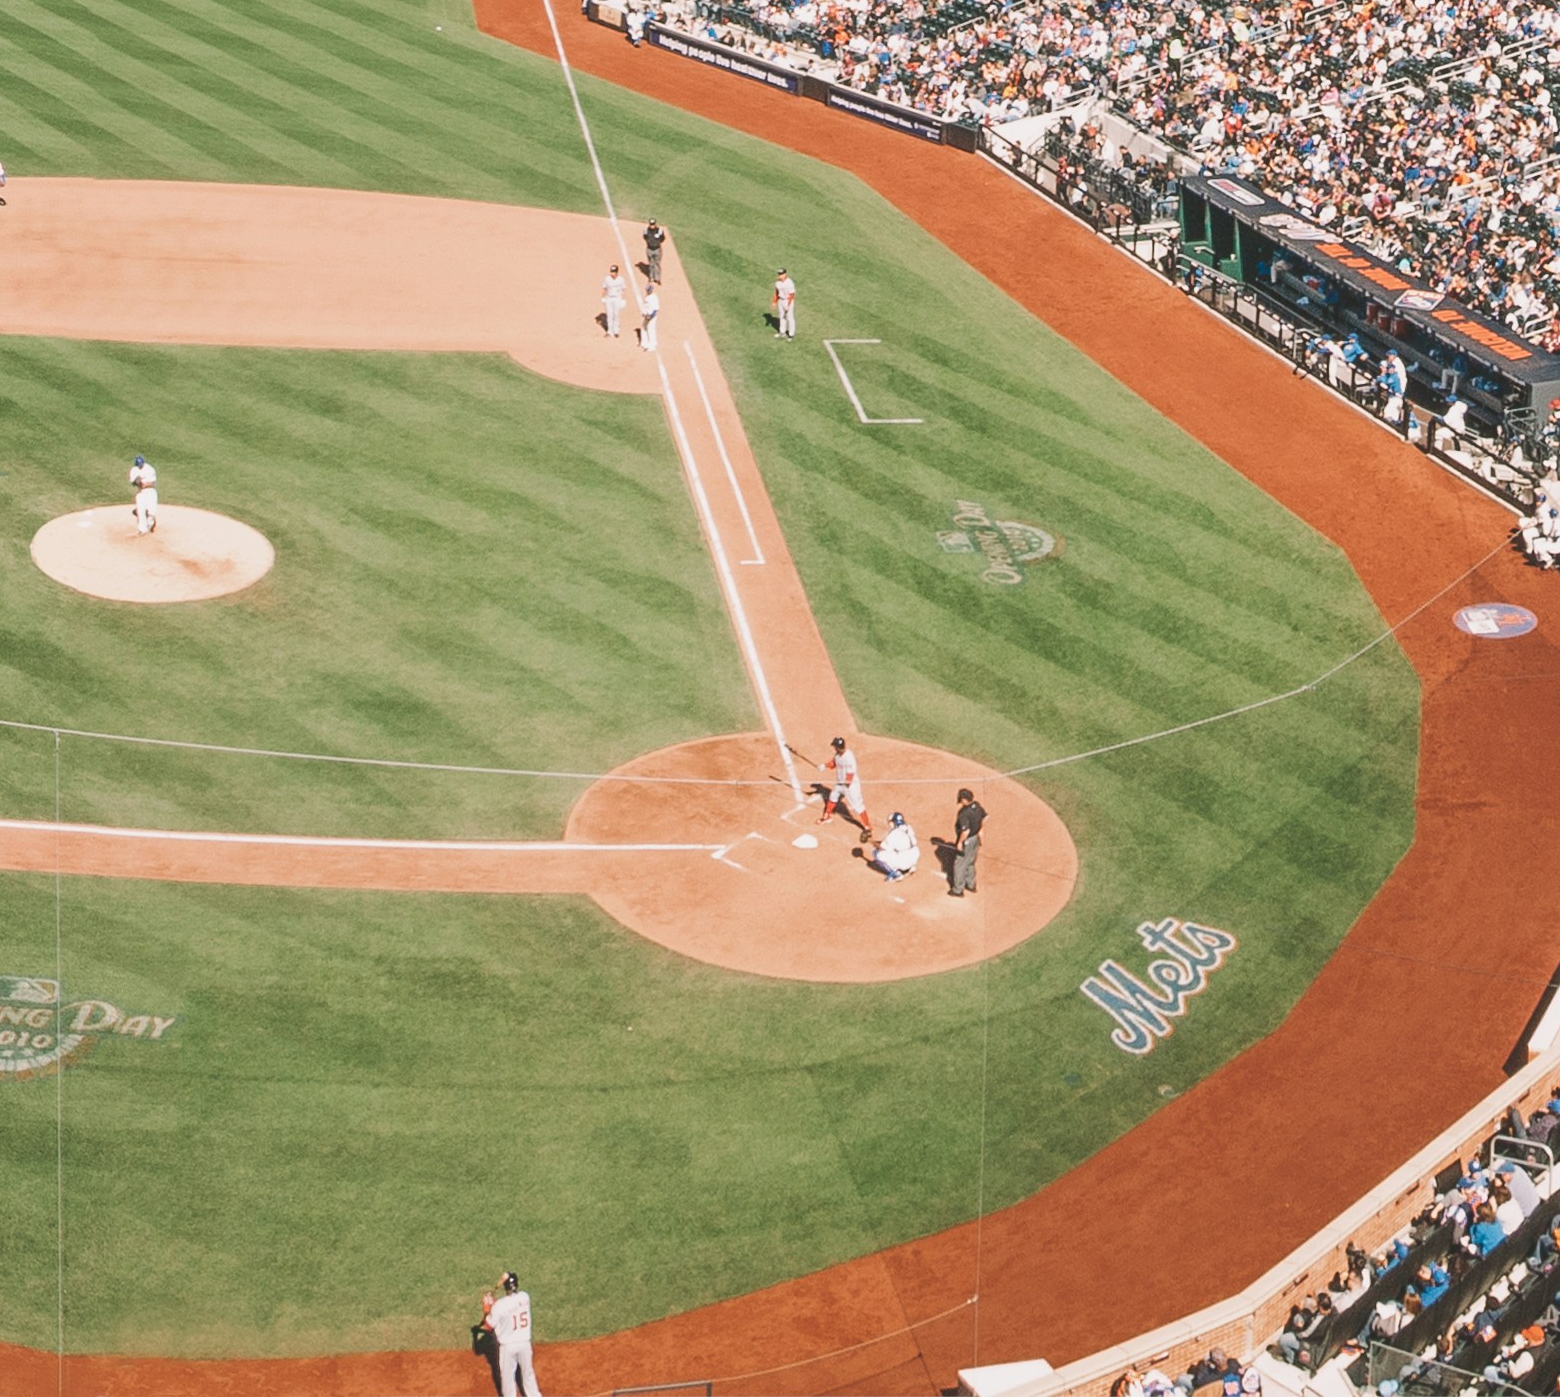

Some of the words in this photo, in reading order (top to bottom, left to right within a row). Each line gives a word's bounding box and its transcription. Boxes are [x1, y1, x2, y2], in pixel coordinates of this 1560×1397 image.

[1079, 916, 1240, 1056] Mets
[60, 1000, 176, 1040] DAY
[512, 1311, 529, 1332] 15
